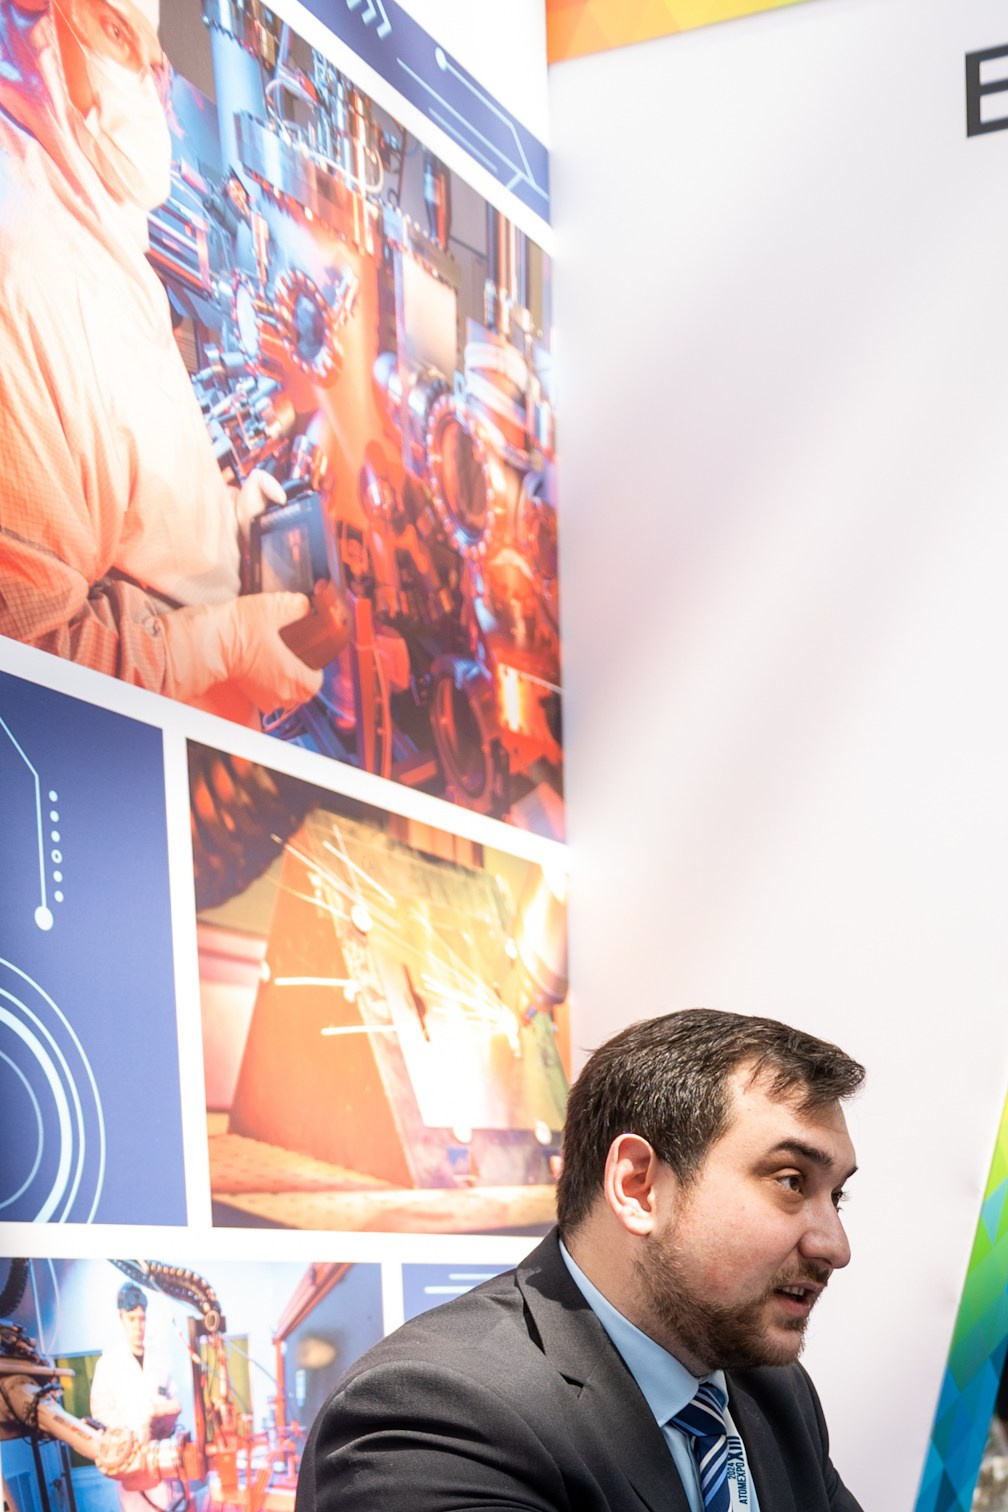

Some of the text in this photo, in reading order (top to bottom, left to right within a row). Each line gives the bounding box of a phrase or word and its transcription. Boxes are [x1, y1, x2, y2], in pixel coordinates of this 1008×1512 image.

[726, 1436, 744, 1461] XIII
[727, 1462, 737, 1480] 2024
[736, 1462, 748, 1505] ATOMEXPO
